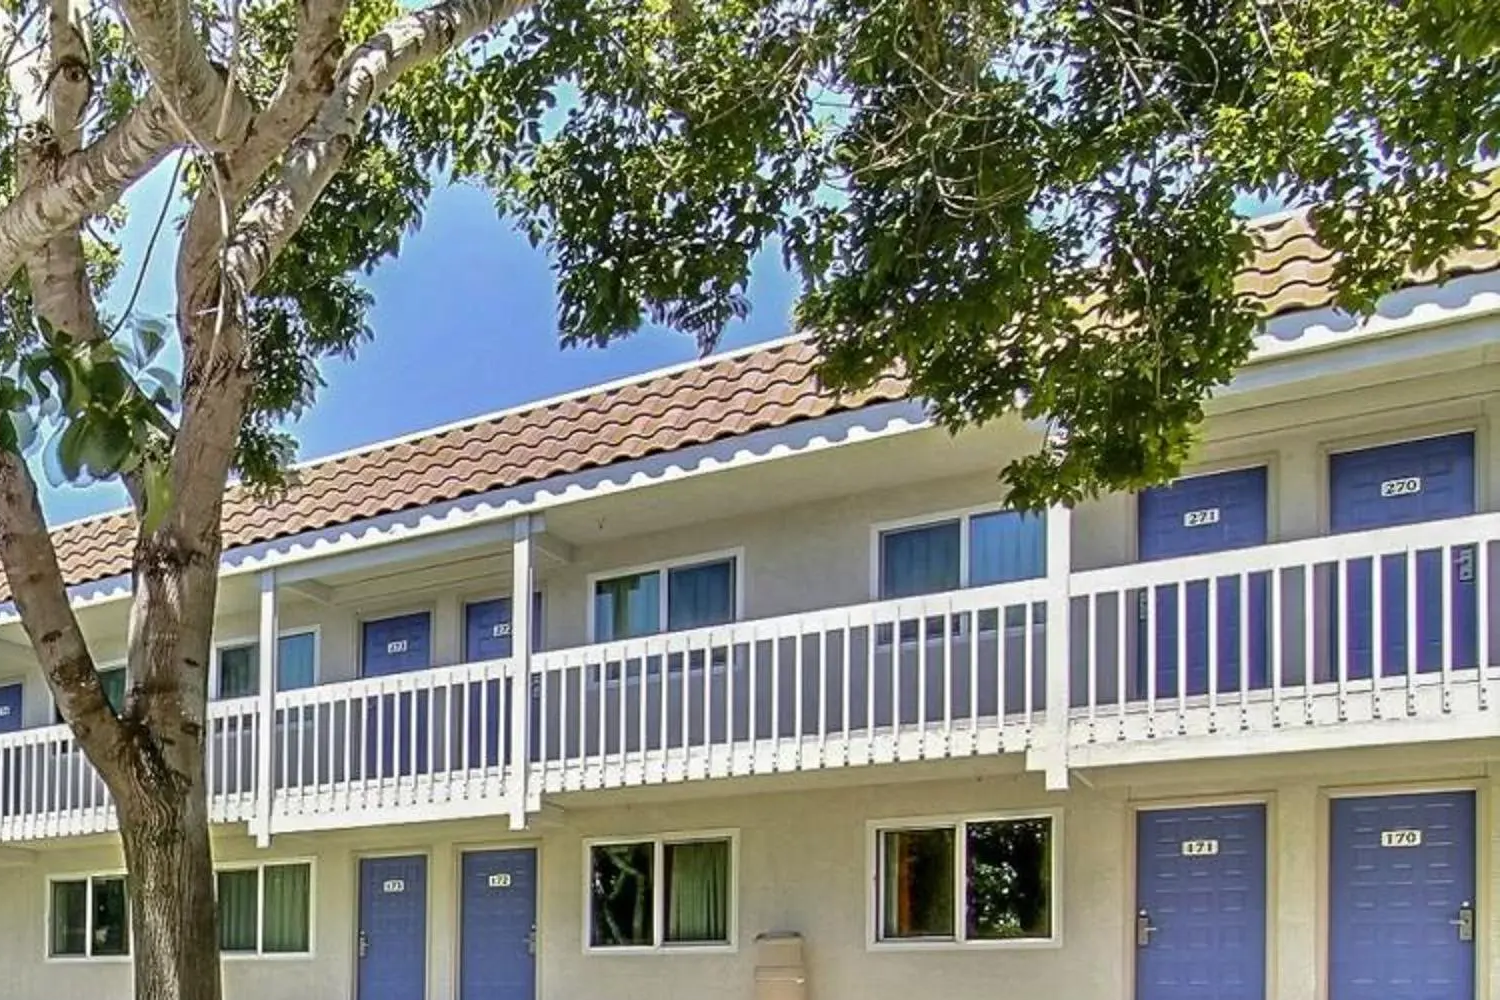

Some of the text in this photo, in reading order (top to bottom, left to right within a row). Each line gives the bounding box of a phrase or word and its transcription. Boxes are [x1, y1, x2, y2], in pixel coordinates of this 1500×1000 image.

[1385, 479, 1417, 495] 270
[1187, 510, 1216, 525] 271
[1386, 831, 1417, 845] 170
[1186, 841, 1213, 854] 171
